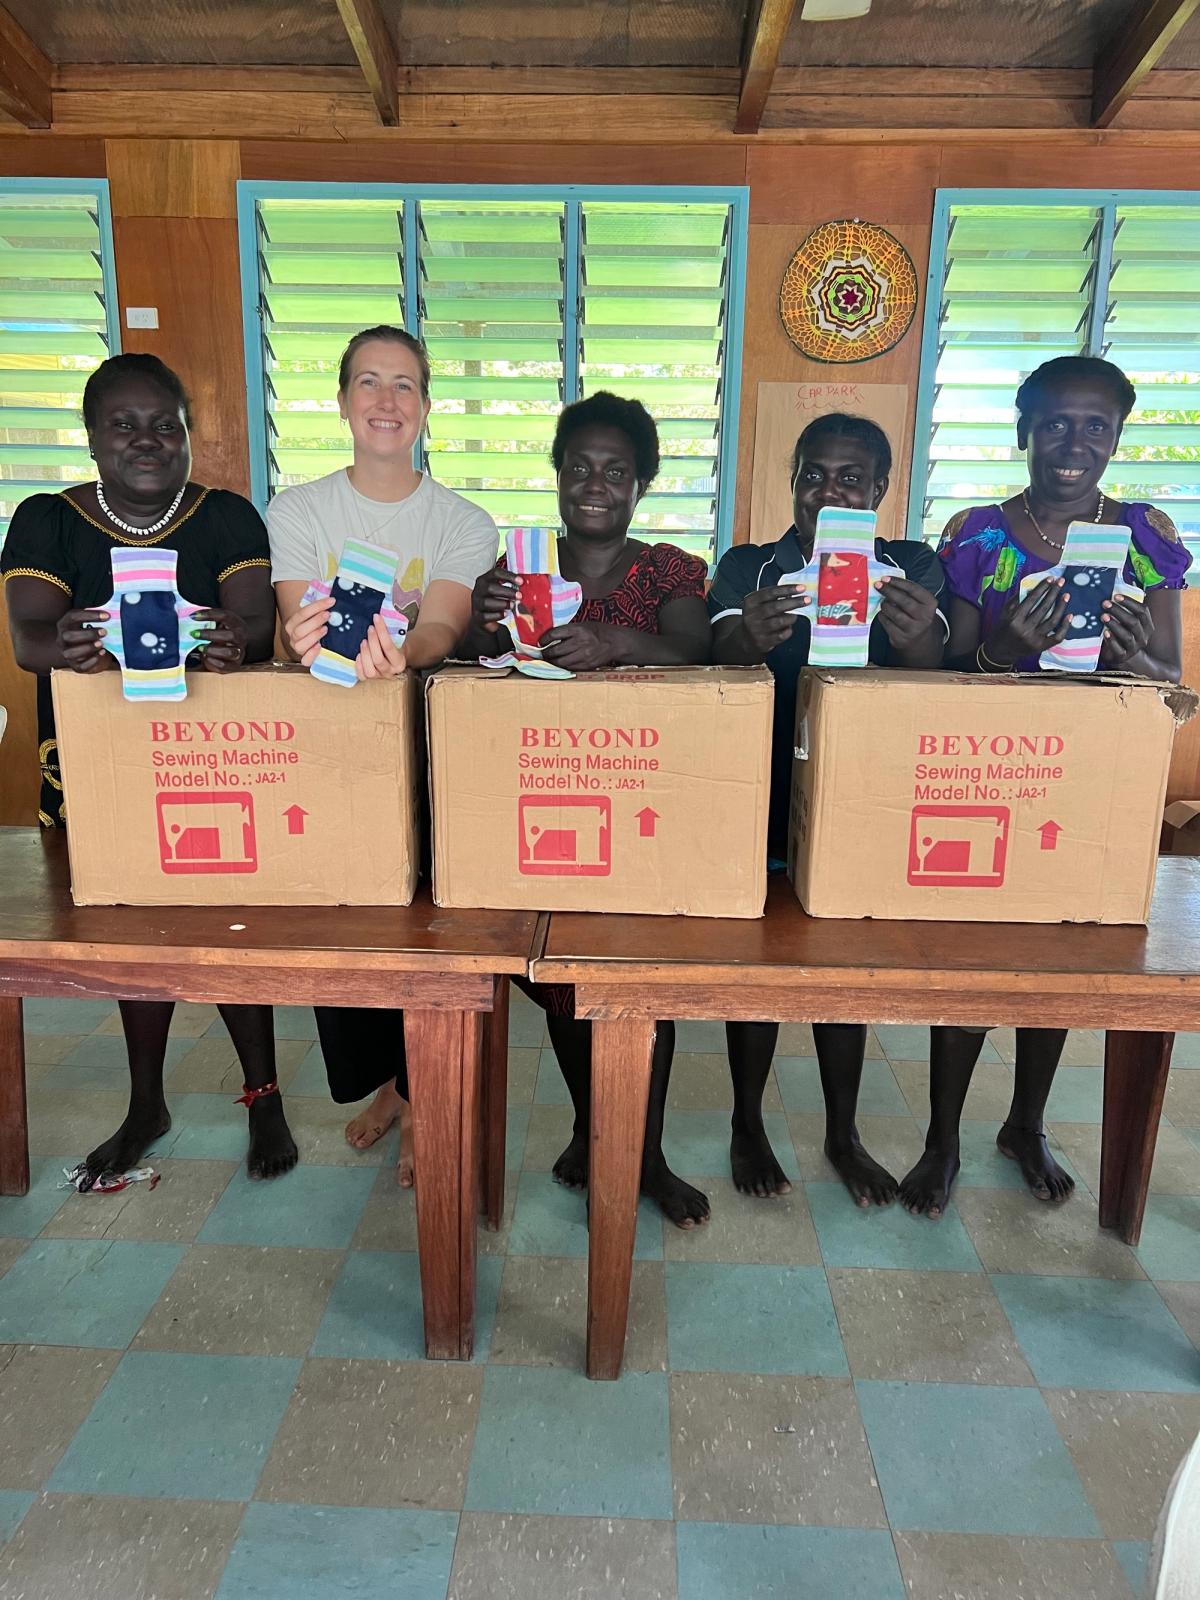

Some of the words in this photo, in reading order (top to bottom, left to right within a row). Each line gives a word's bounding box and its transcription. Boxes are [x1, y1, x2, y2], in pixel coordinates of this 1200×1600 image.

[798, 385, 822, 399] CAR
[827, 385, 857, 397] PARK
[151, 722, 295, 742] BEYOND
[520, 728, 660, 749] BEYOND
[917, 735, 1065, 756] BEYOND
[153, 751, 218, 770] Sewing
[223, 749, 300, 766] Machine
[519, 753, 581, 773] Sewing
[586, 755, 660, 771] Machine
[155, 772, 210, 788] Model
[520, 774, 571, 789] Model
[915, 764, 982, 784] Sewing
[987, 764, 1064, 780] Machine
[915, 785, 970, 801] Model
